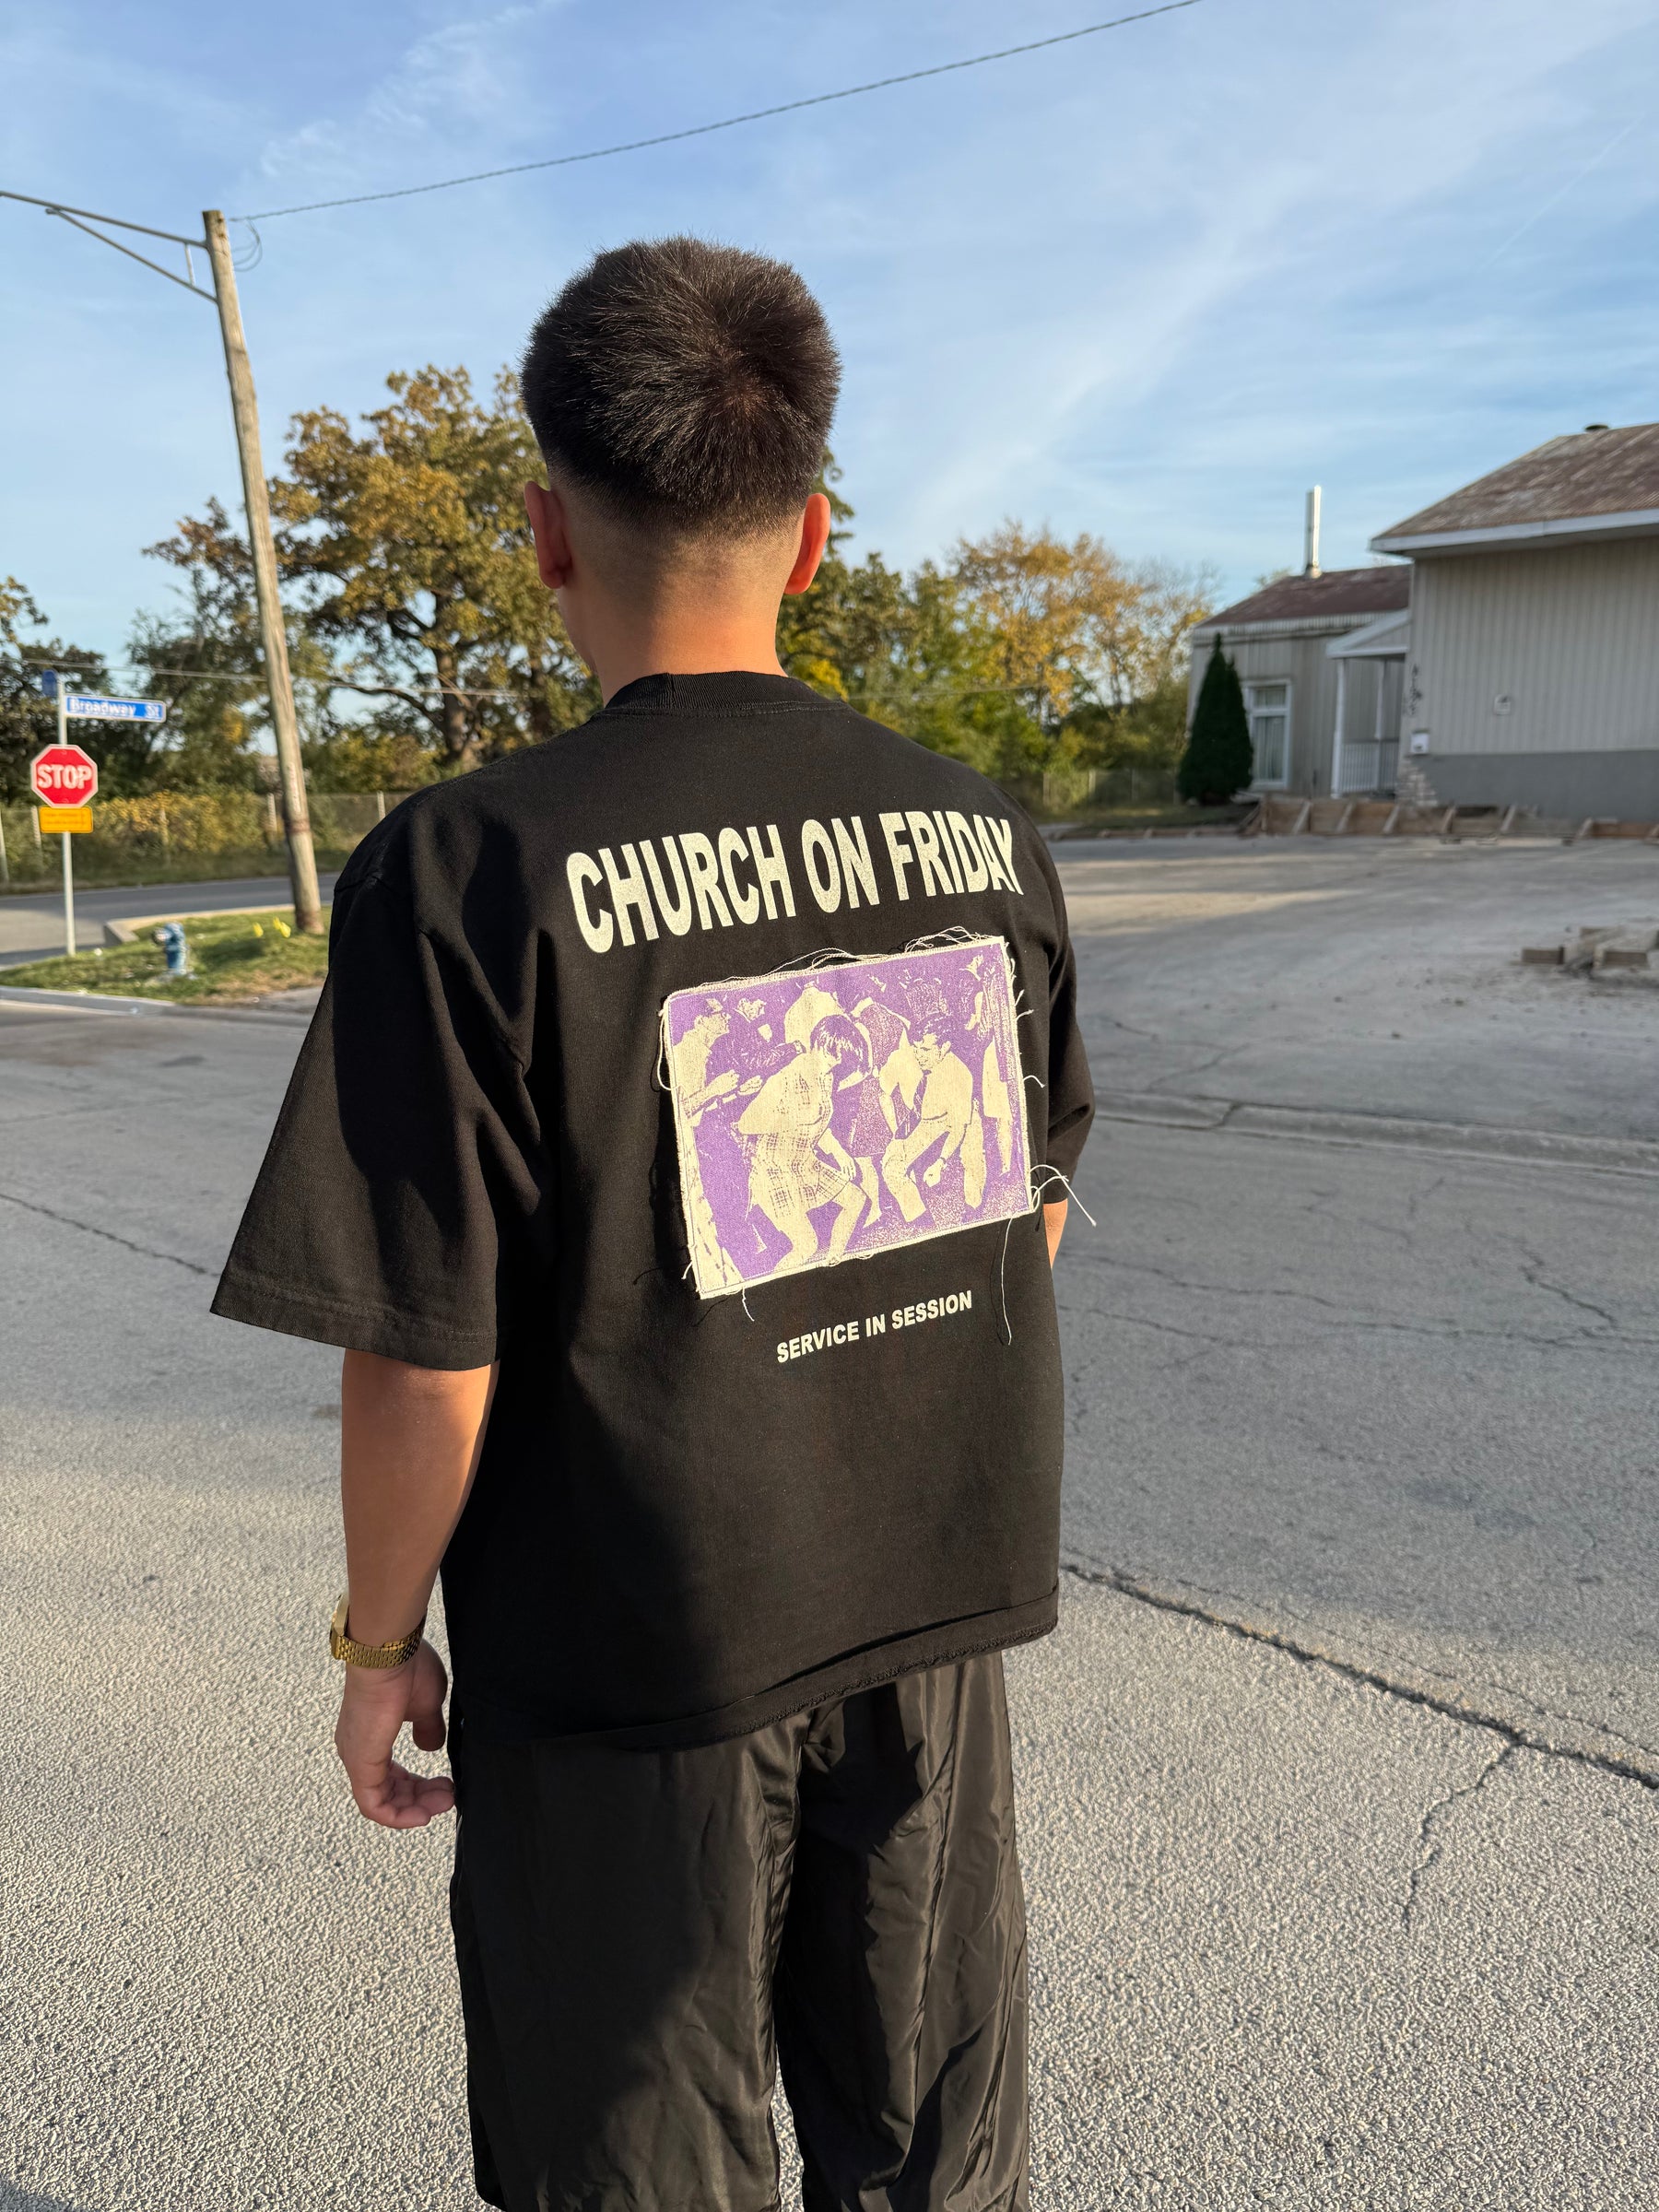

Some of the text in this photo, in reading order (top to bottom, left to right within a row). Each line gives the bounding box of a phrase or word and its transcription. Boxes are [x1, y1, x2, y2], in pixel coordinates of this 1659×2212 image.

[70, 697, 159, 718] Broadway St
[37, 764, 91, 789] STOP
[566, 810, 1024, 953] CHURCH ON FRIDAY
[776, 1290, 972, 1363] SERVICE IN SESSION
